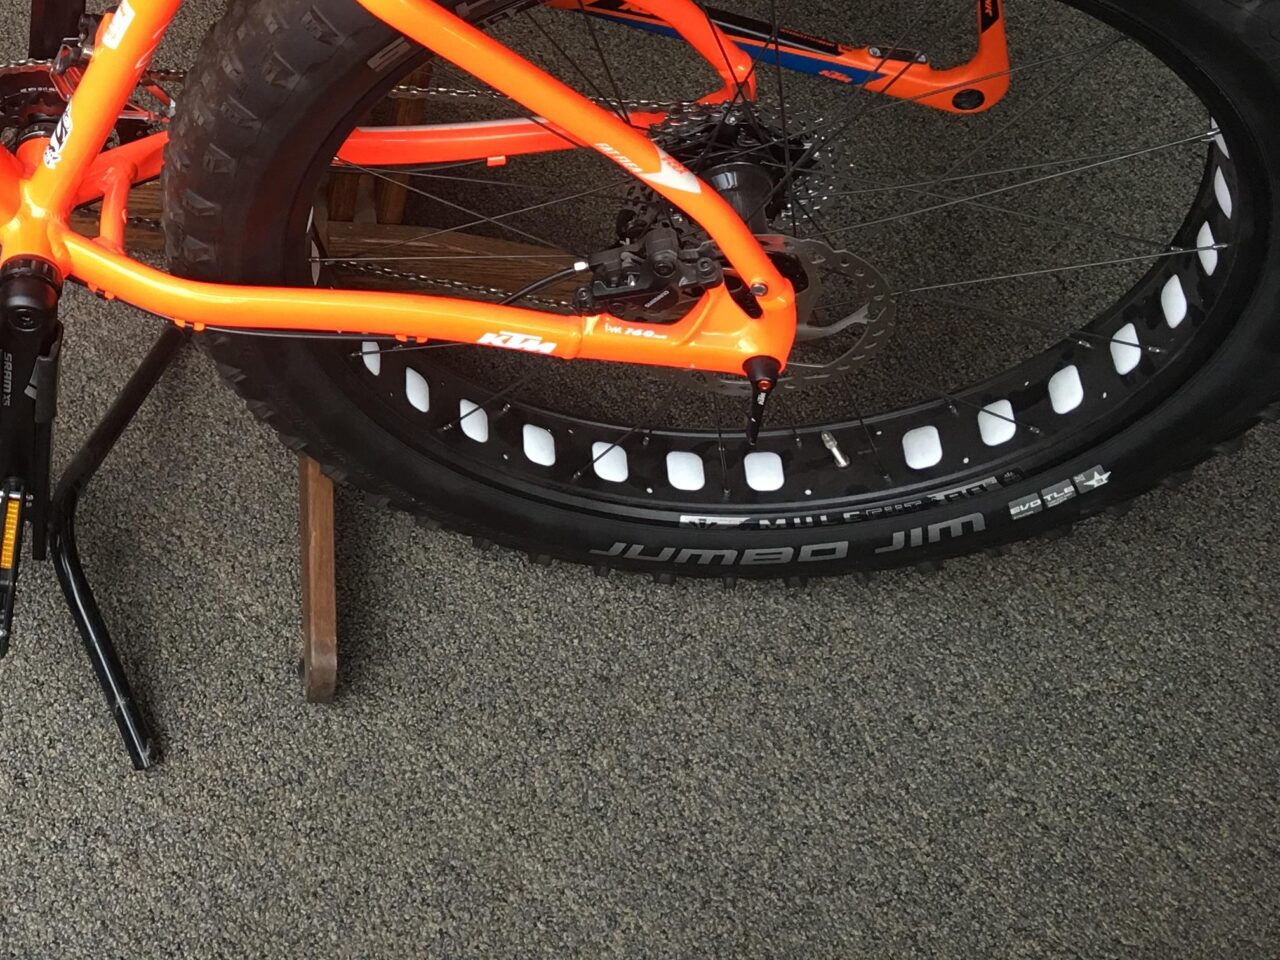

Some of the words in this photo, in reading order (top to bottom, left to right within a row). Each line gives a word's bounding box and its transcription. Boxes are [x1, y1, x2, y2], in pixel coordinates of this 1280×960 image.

[594, 143, 620, 155] FAT
[612, 155, 644, 173] FLEA
[477, 330, 558, 355] KTM
[3, 352, 13, 394] SRAM
[1009, 498, 1043, 515] EVO
[589, 541, 849, 566] JUMBO
[875, 512, 986, 554] JIM
